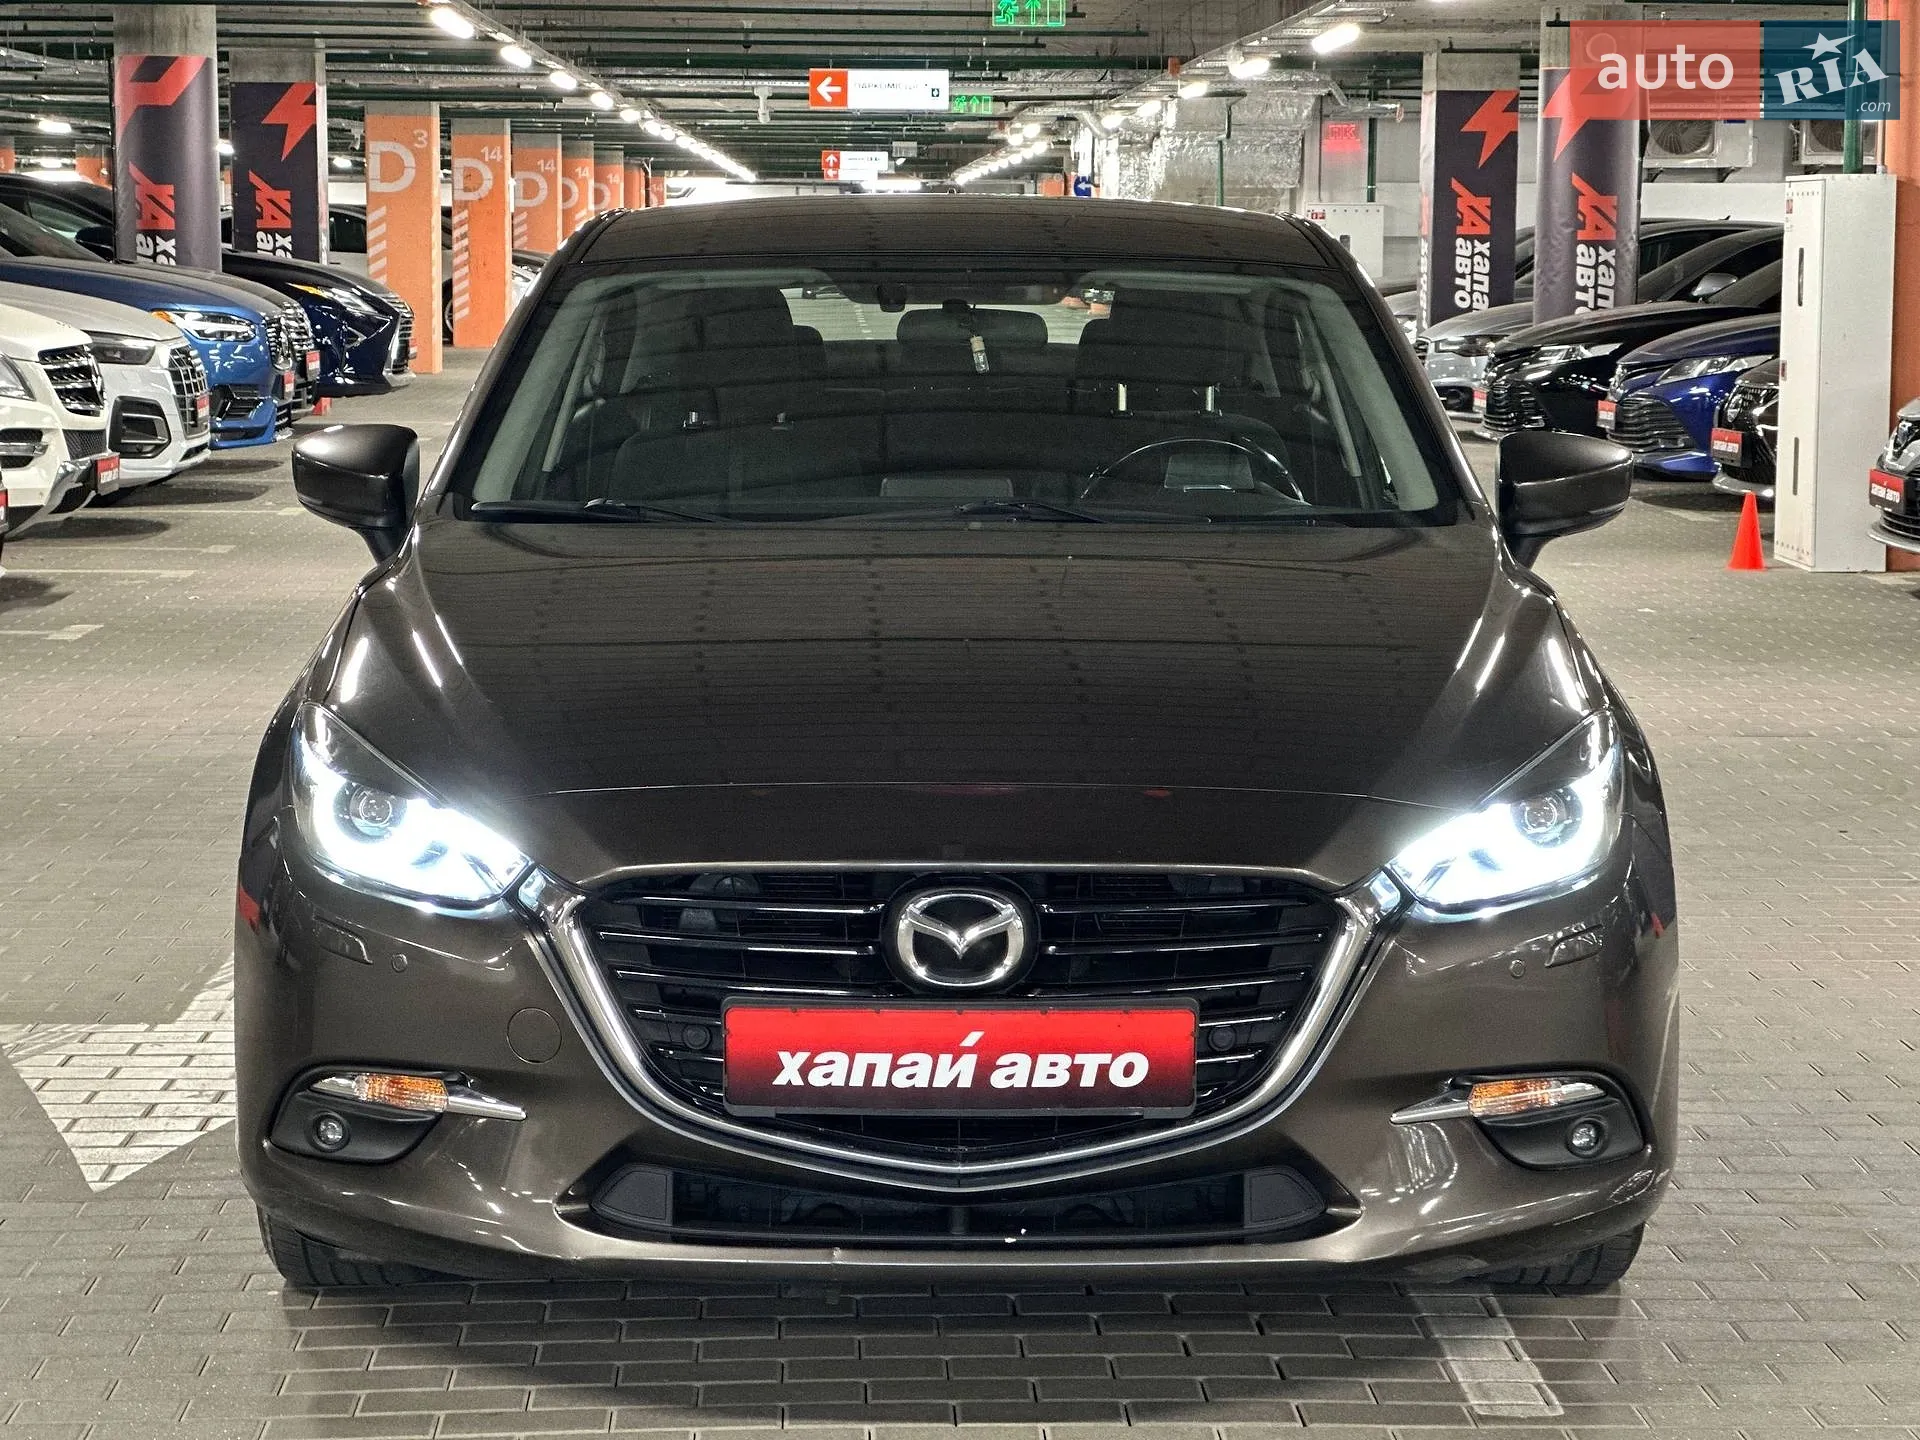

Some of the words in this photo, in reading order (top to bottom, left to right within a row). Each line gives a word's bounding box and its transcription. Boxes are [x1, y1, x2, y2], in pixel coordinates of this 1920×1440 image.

[368, 141, 416, 193] D
[413, 129, 429, 148] 3
[452, 157, 494, 201] D
[480, 145, 503, 162] 14
[513, 170, 549, 208] D
[537, 158, 557, 173] 14
[574, 165, 591, 179] 14
[606, 172, 621, 185] 14
[1454, 238, 1472, 309] авто
[1472, 239, 1491, 311] хапа
[1597, 246, 1616, 309] хап
[772, 1031, 985, 1089] хапай
[990, 1051, 1150, 1089] авто
